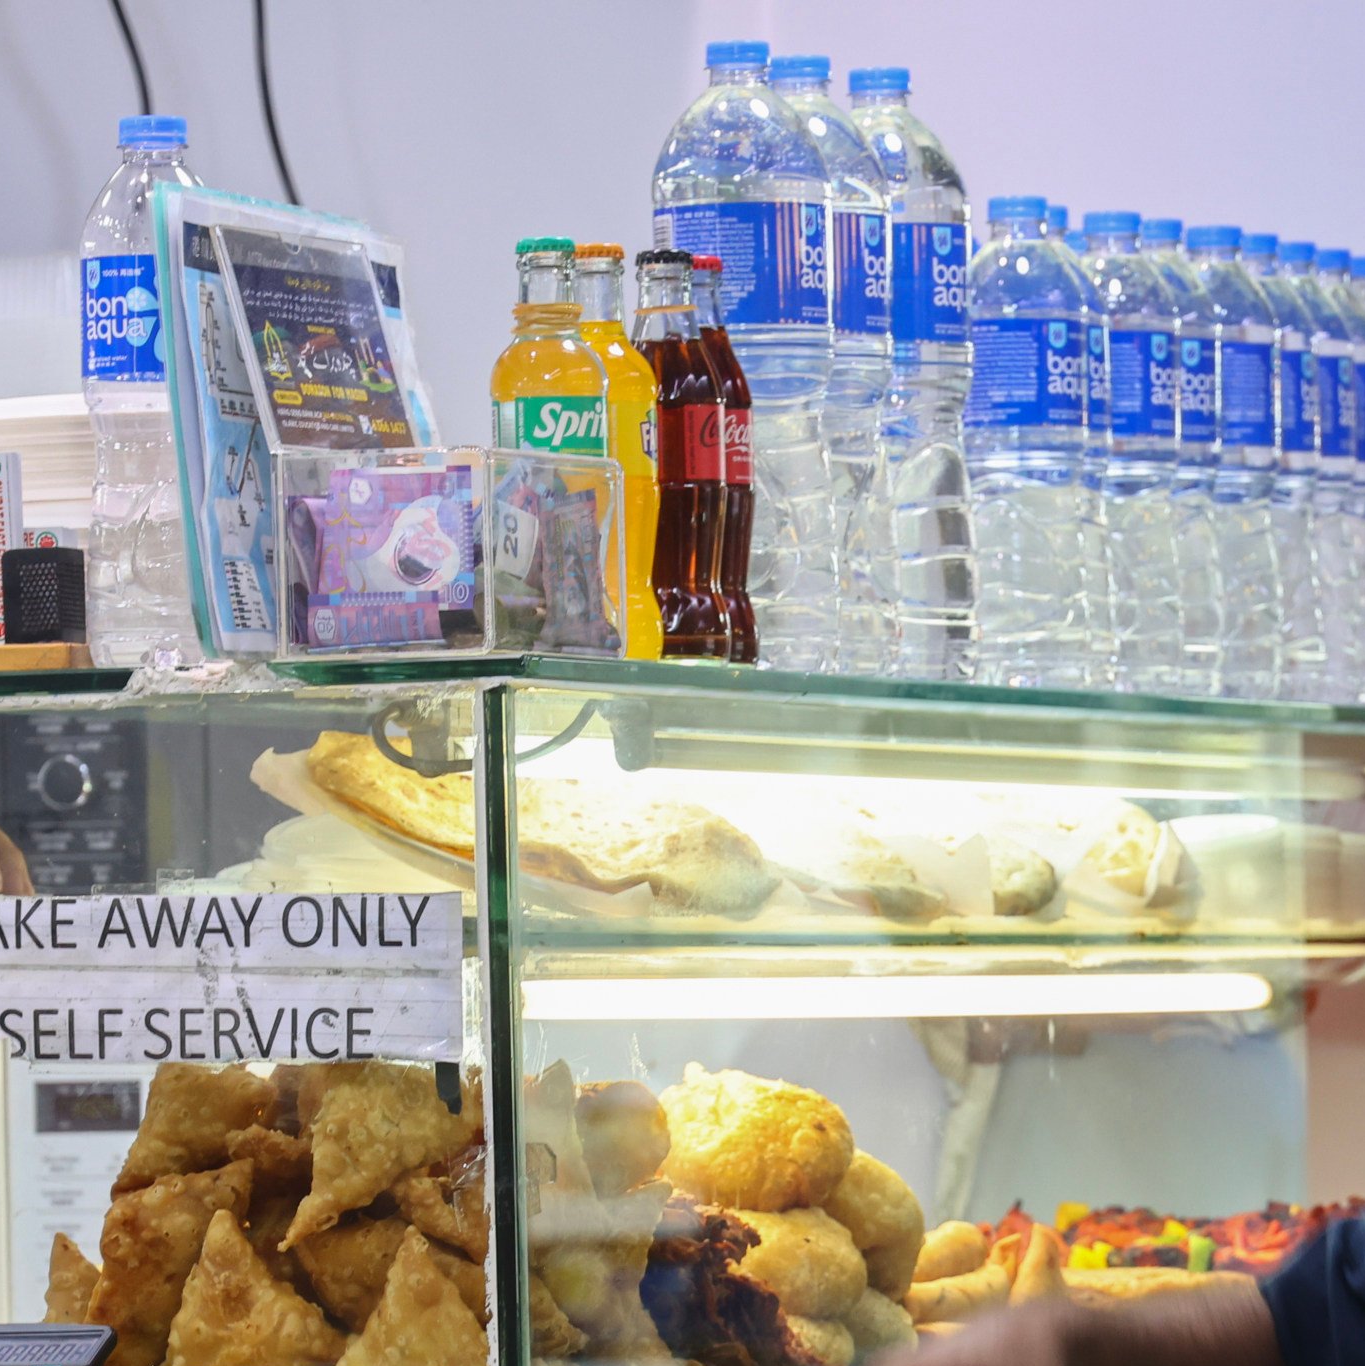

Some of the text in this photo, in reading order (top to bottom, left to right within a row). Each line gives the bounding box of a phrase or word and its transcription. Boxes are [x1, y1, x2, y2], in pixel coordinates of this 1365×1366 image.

[86, 292, 128, 319] bon
[86, 317, 146, 345] aqua
[533, 402, 607, 446] Spri
[503, 513, 519, 559] 20
[98, 897, 262, 949] AWAY
[281, 896, 431, 949] ONLY
[0, 1007, 374, 1060] SELF SERVICE
